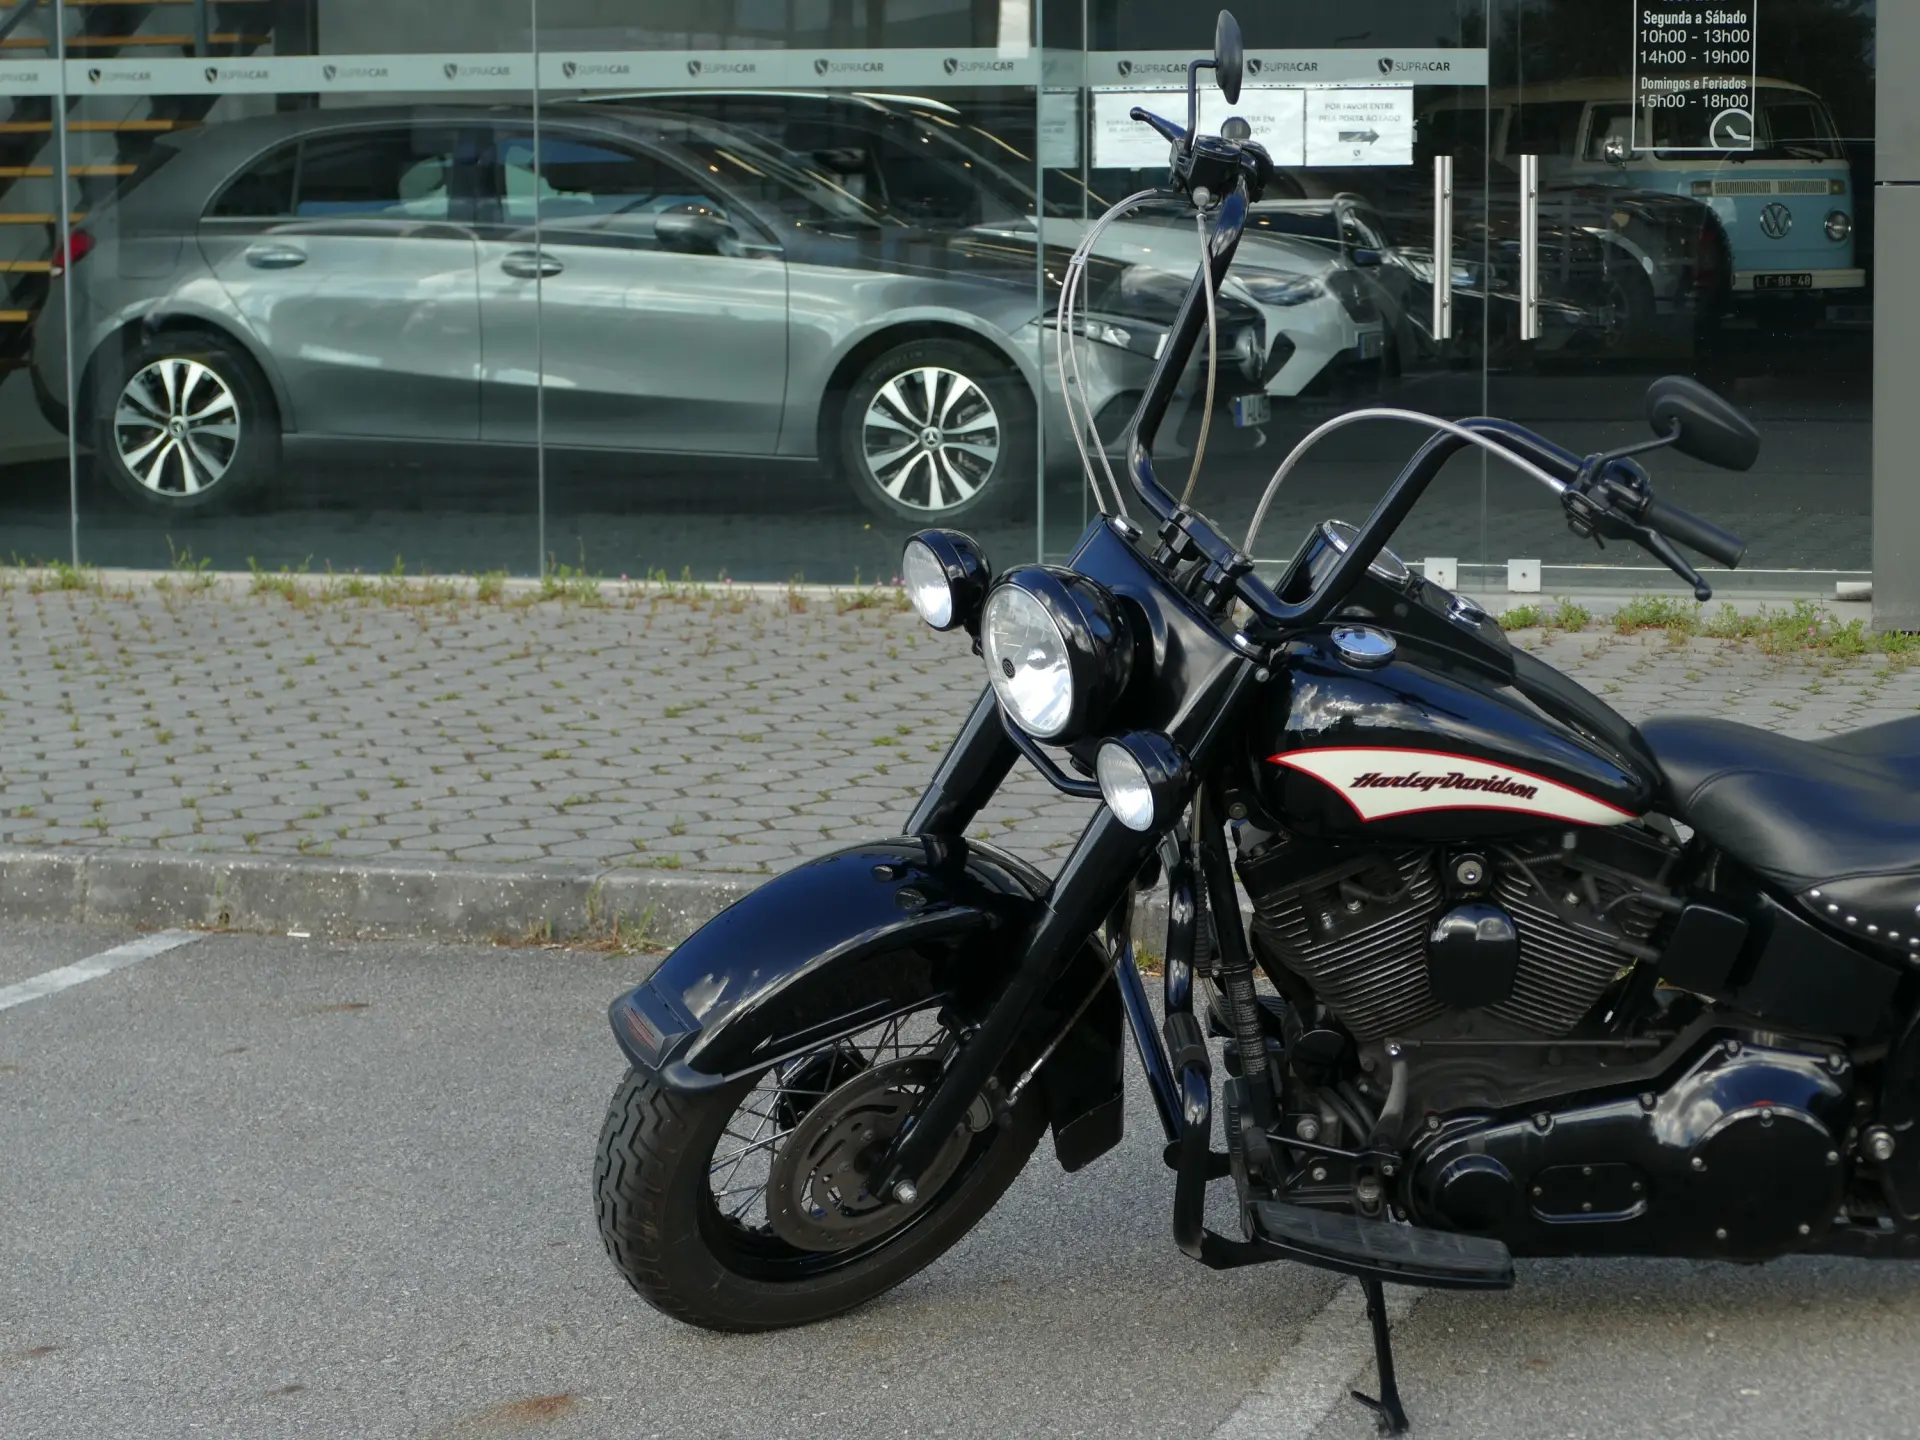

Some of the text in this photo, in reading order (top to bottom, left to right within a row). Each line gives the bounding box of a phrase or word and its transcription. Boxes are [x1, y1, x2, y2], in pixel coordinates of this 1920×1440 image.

[1643, 10, 1747, 28] Segunda a Sábado
[1640, 30, 1687, 43] 10h00
[1703, 30, 1750, 43] 13h00
[1640, 50, 1687, 64] 14h00
[1702, 50, 1750, 64] 19h00
[459, 66, 511, 76] SUPRACAR
[578, 64, 631, 75] SUPRACAR
[703, 63, 756, 74] SUPRACAR
[830, 62, 884, 73] SUPRACAR
[959, 61, 1014, 72] SUPRACAR
[1133, 62, 1188, 74] SUPRACAR
[1263, 61, 1318, 72] SUPRACAR
[1395, 61, 1451, 72] SUPRACAR
[1641, 76, 1747, 92] Domingos e Feriados
[1343, 102, 1368, 110] FAVOR
[1370, 101, 1394, 110] ENTRE
[1639, 94, 1686, 108] 15h00
[1702, 94, 1749, 108] 18h00
